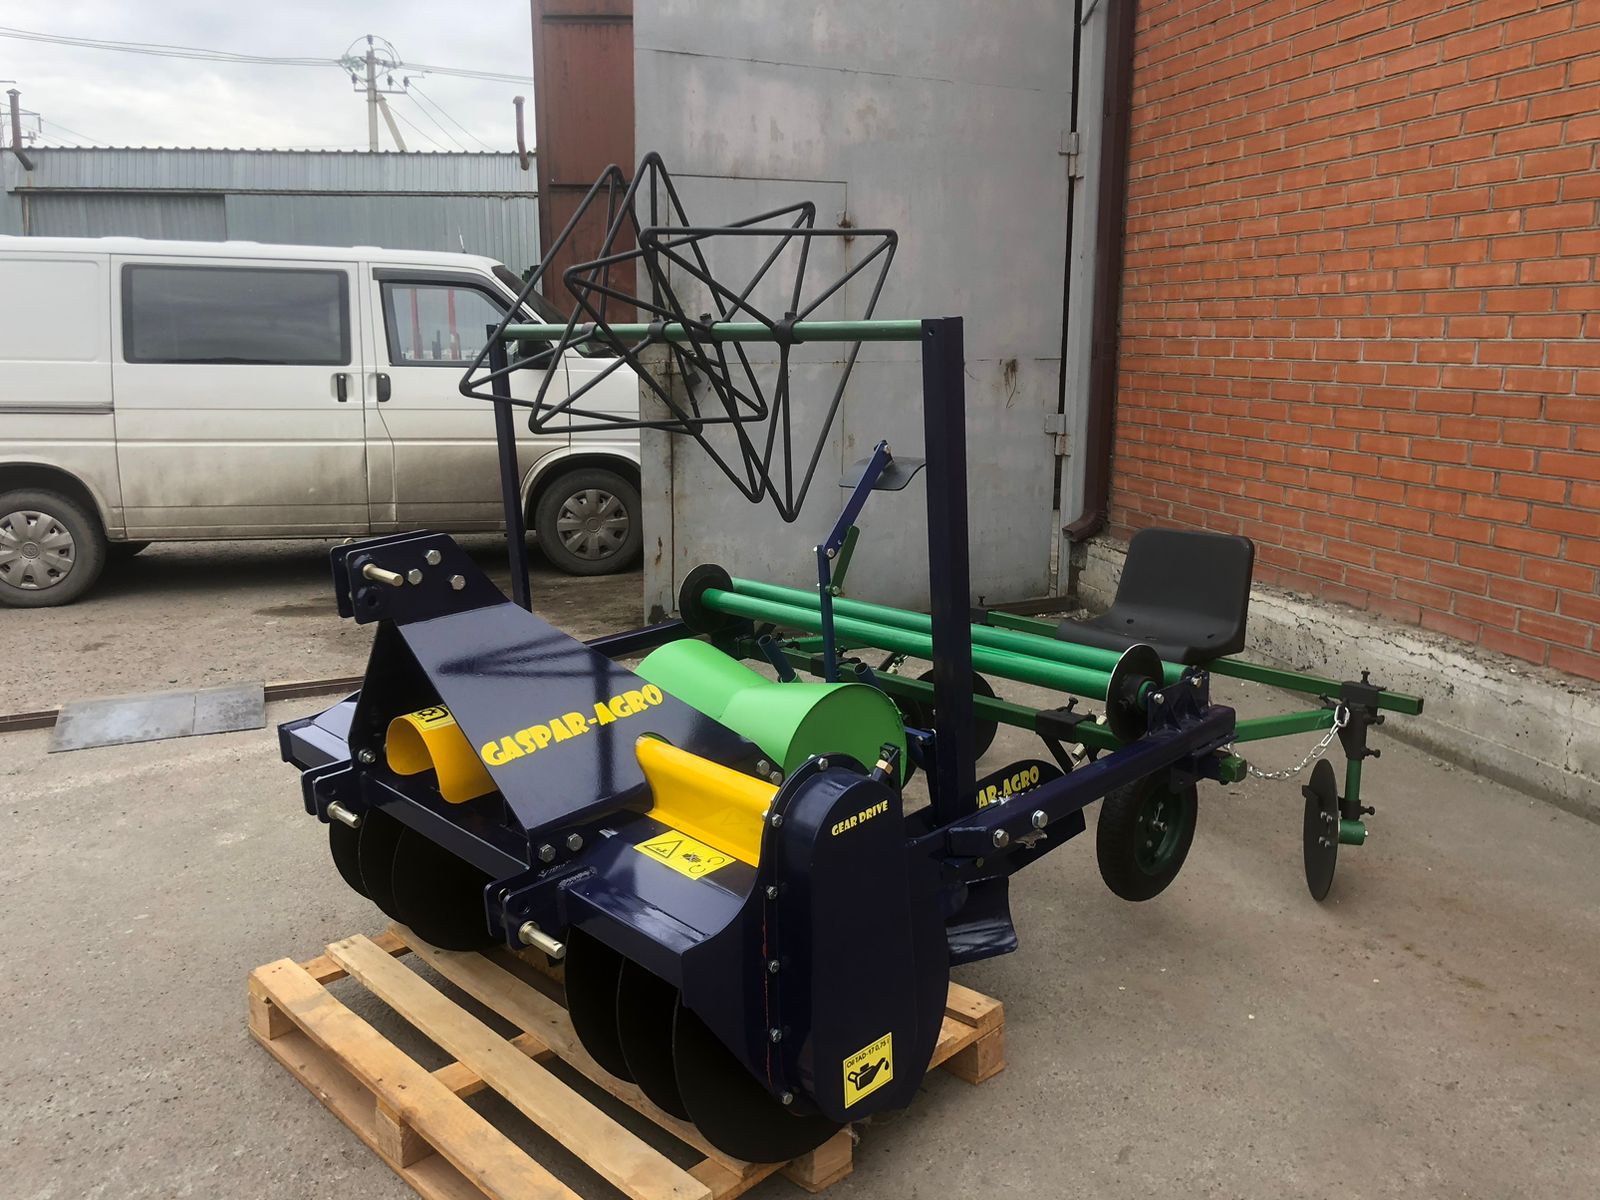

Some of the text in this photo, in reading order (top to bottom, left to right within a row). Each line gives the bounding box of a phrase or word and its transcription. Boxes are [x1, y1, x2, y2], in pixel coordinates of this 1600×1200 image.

[480, 684, 664, 766] GASPAR-AGRO
[975, 765, 1040, 809] AR-AGRO
[831, 799, 889, 836] GEAR DRIVE
